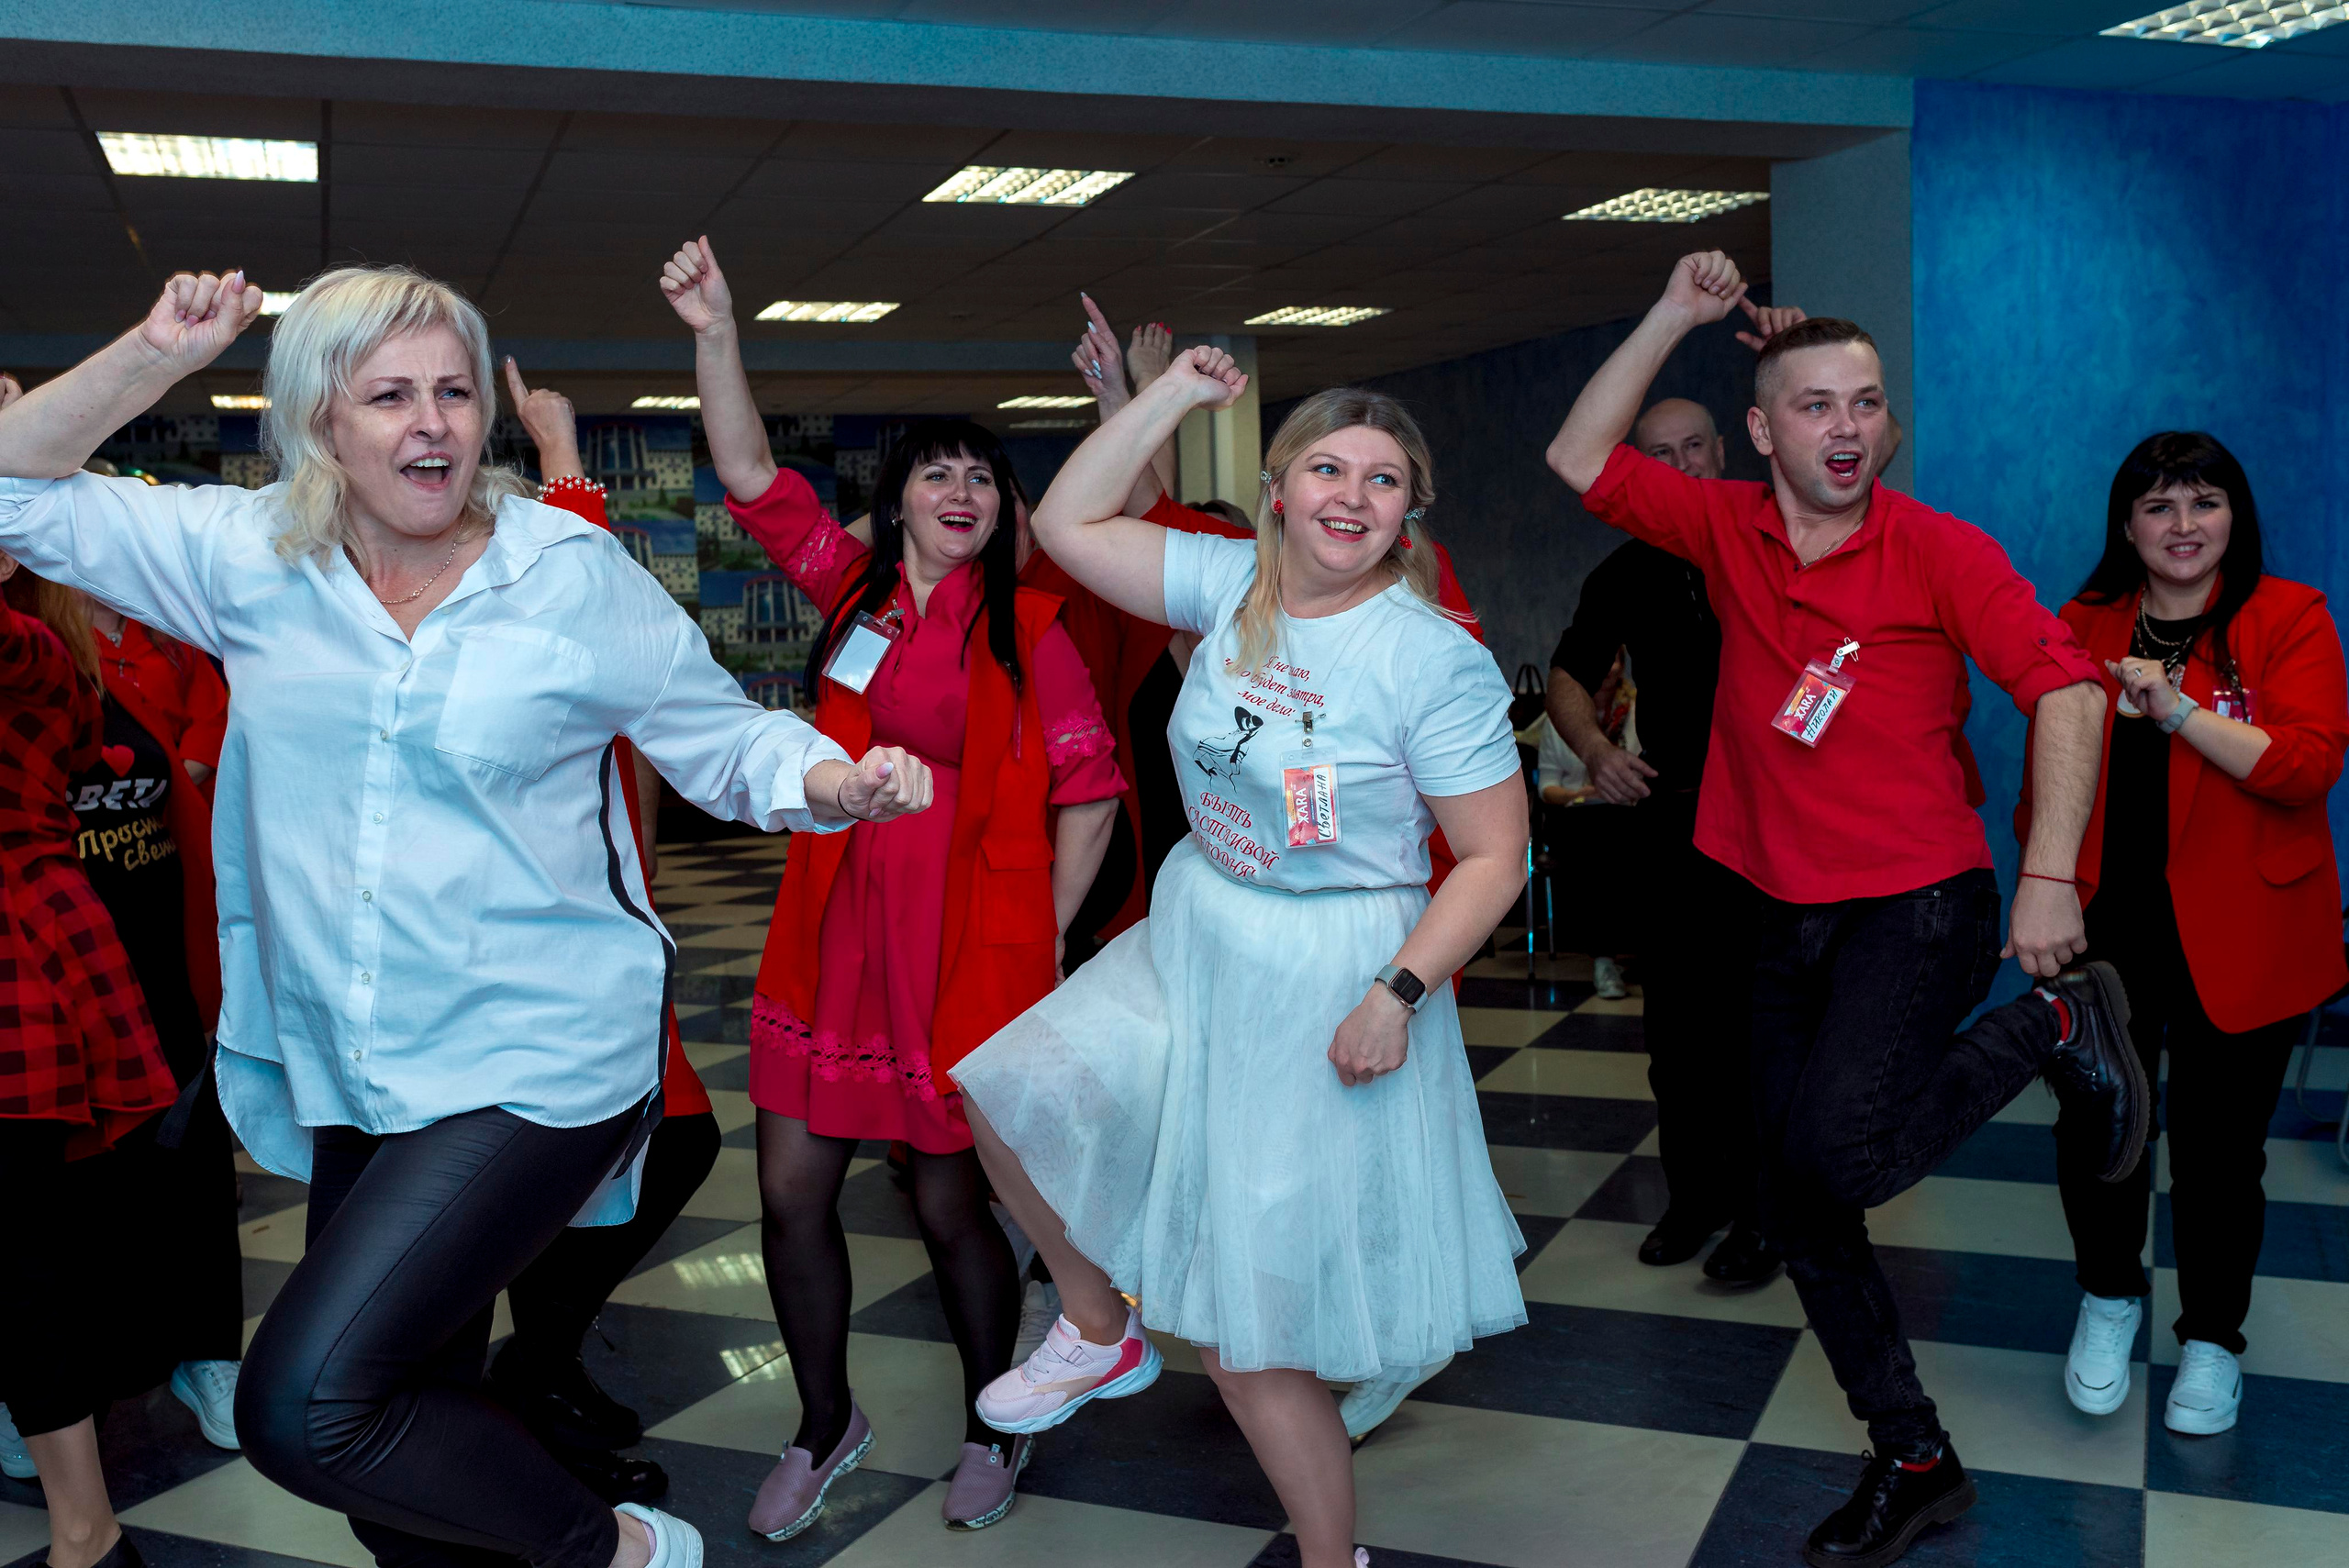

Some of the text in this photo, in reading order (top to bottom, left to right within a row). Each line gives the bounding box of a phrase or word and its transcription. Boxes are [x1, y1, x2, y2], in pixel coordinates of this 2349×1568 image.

[1273, 662, 1290, 673] не
[1199, 791, 1252, 828] БЫТЬ
[77, 817, 165, 862] Прост
